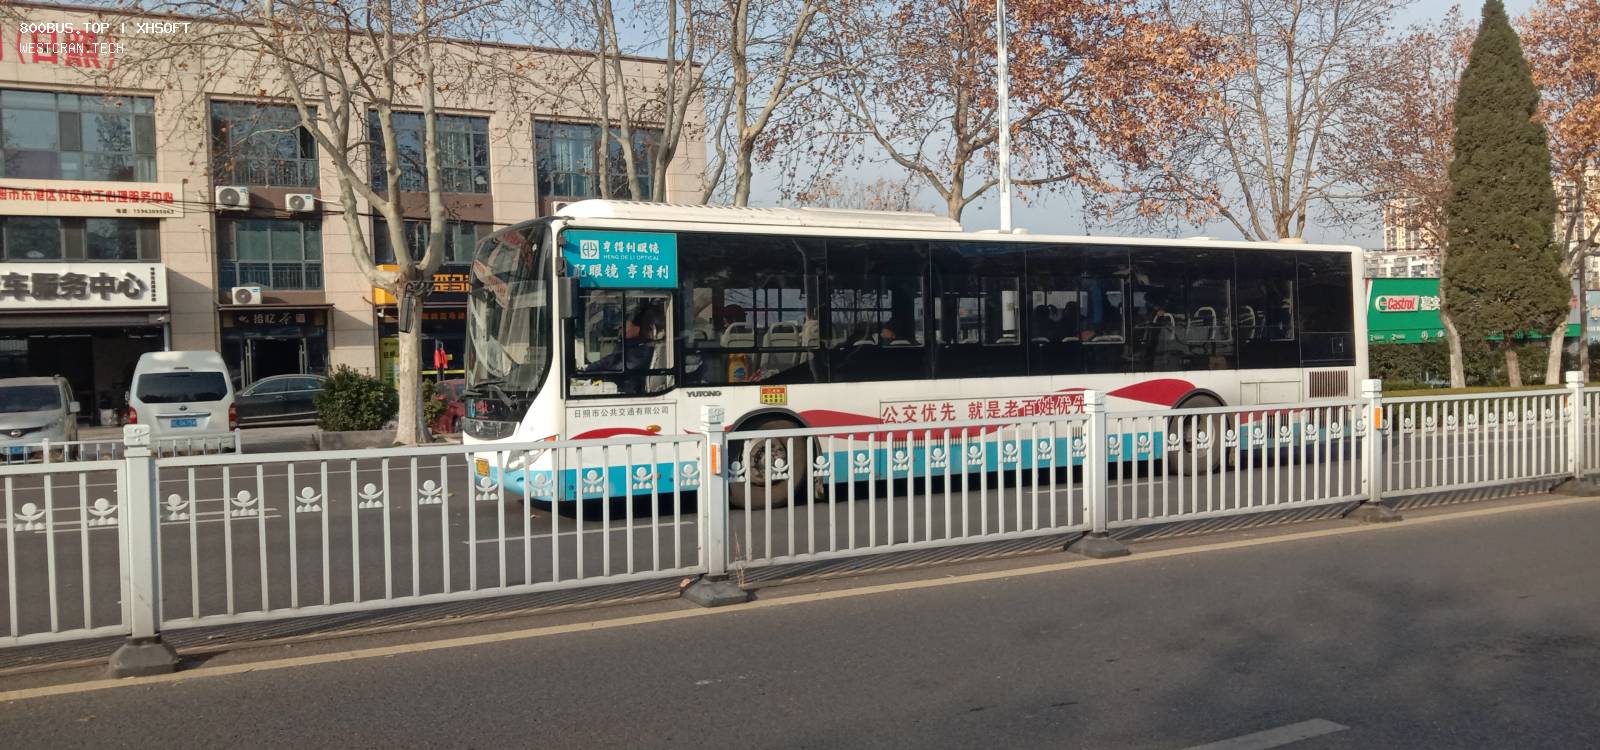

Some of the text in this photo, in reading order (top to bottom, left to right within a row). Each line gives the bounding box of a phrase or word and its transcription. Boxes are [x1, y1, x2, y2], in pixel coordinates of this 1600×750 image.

[602, 240, 660, 254] 亨得利眼镜
[573, 263, 669, 279] 配眼镜 亨得利
[1387, 297, 1416, 310] Castrol
[686, 390, 722, 398] YUTONG
[573, 405, 670, 419] 日照市公共交通有限公司
[881, 394, 1087, 424] 公交优先 就是老百姓优先
